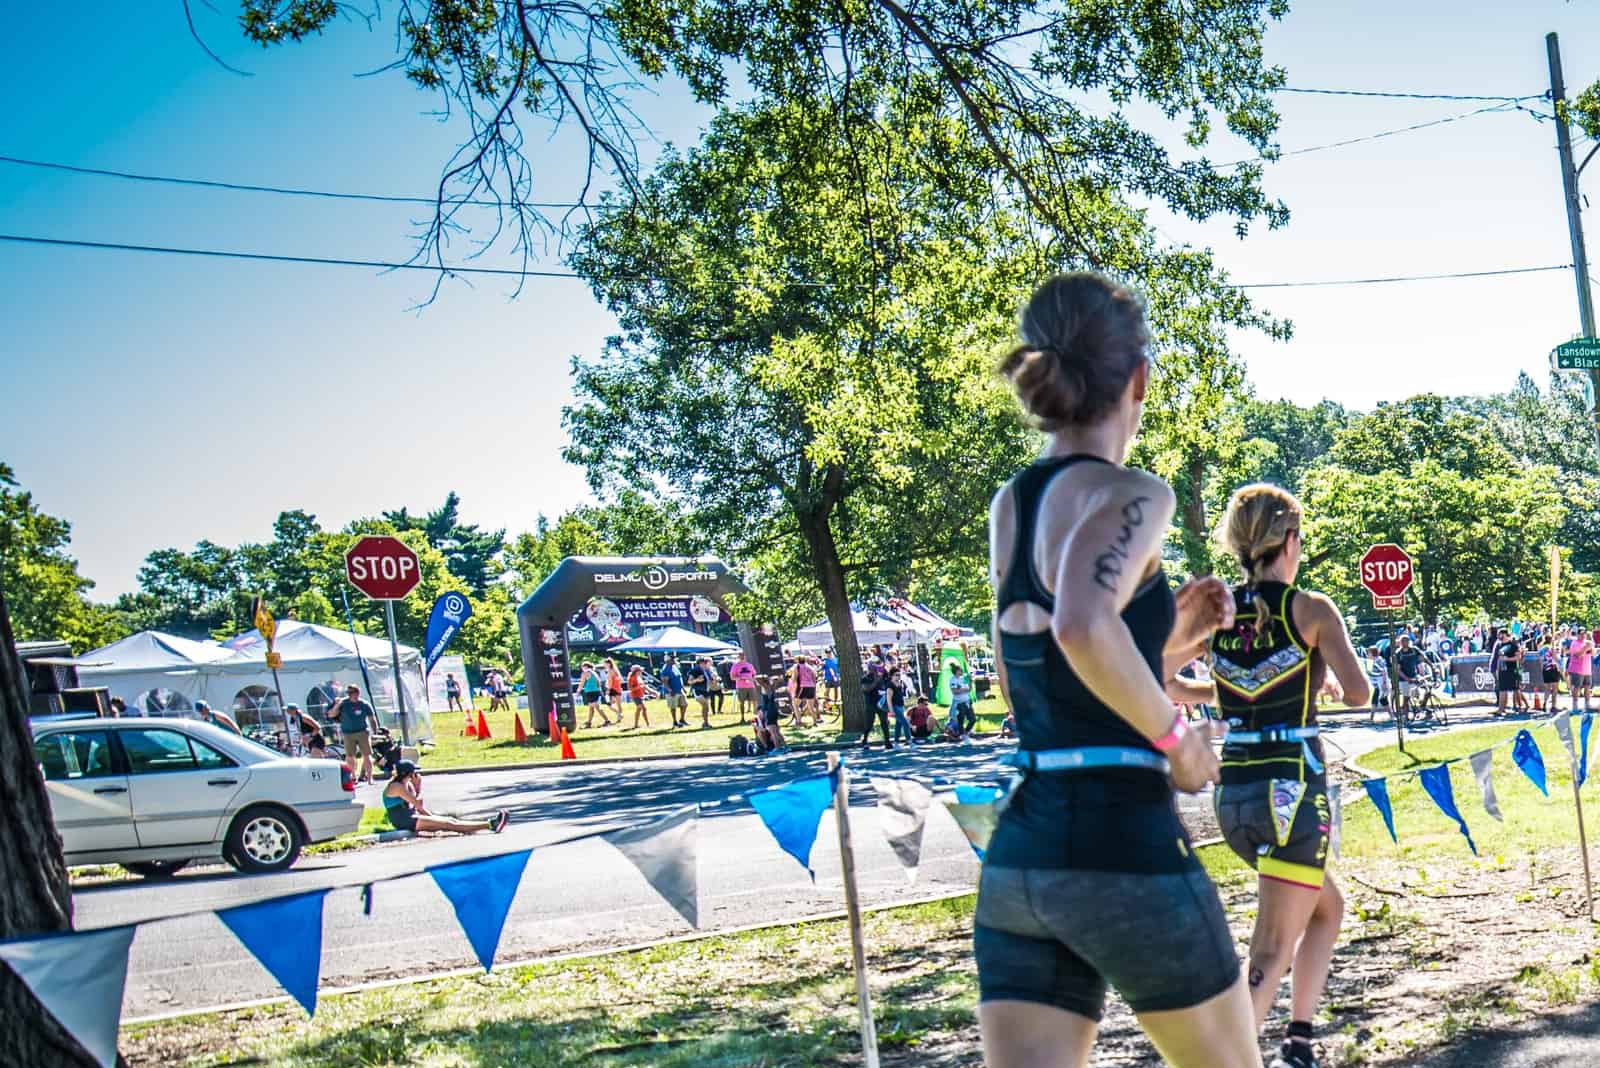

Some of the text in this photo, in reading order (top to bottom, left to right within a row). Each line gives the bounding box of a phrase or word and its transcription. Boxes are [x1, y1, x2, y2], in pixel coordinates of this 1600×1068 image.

[351, 556, 414, 581] STOP
[1364, 560, 1409, 582] STOP
[670, 571, 718, 582] SPORTS
[620, 602, 687, 610] WELCOME
[624, 610, 688, 618] ATHLETES
